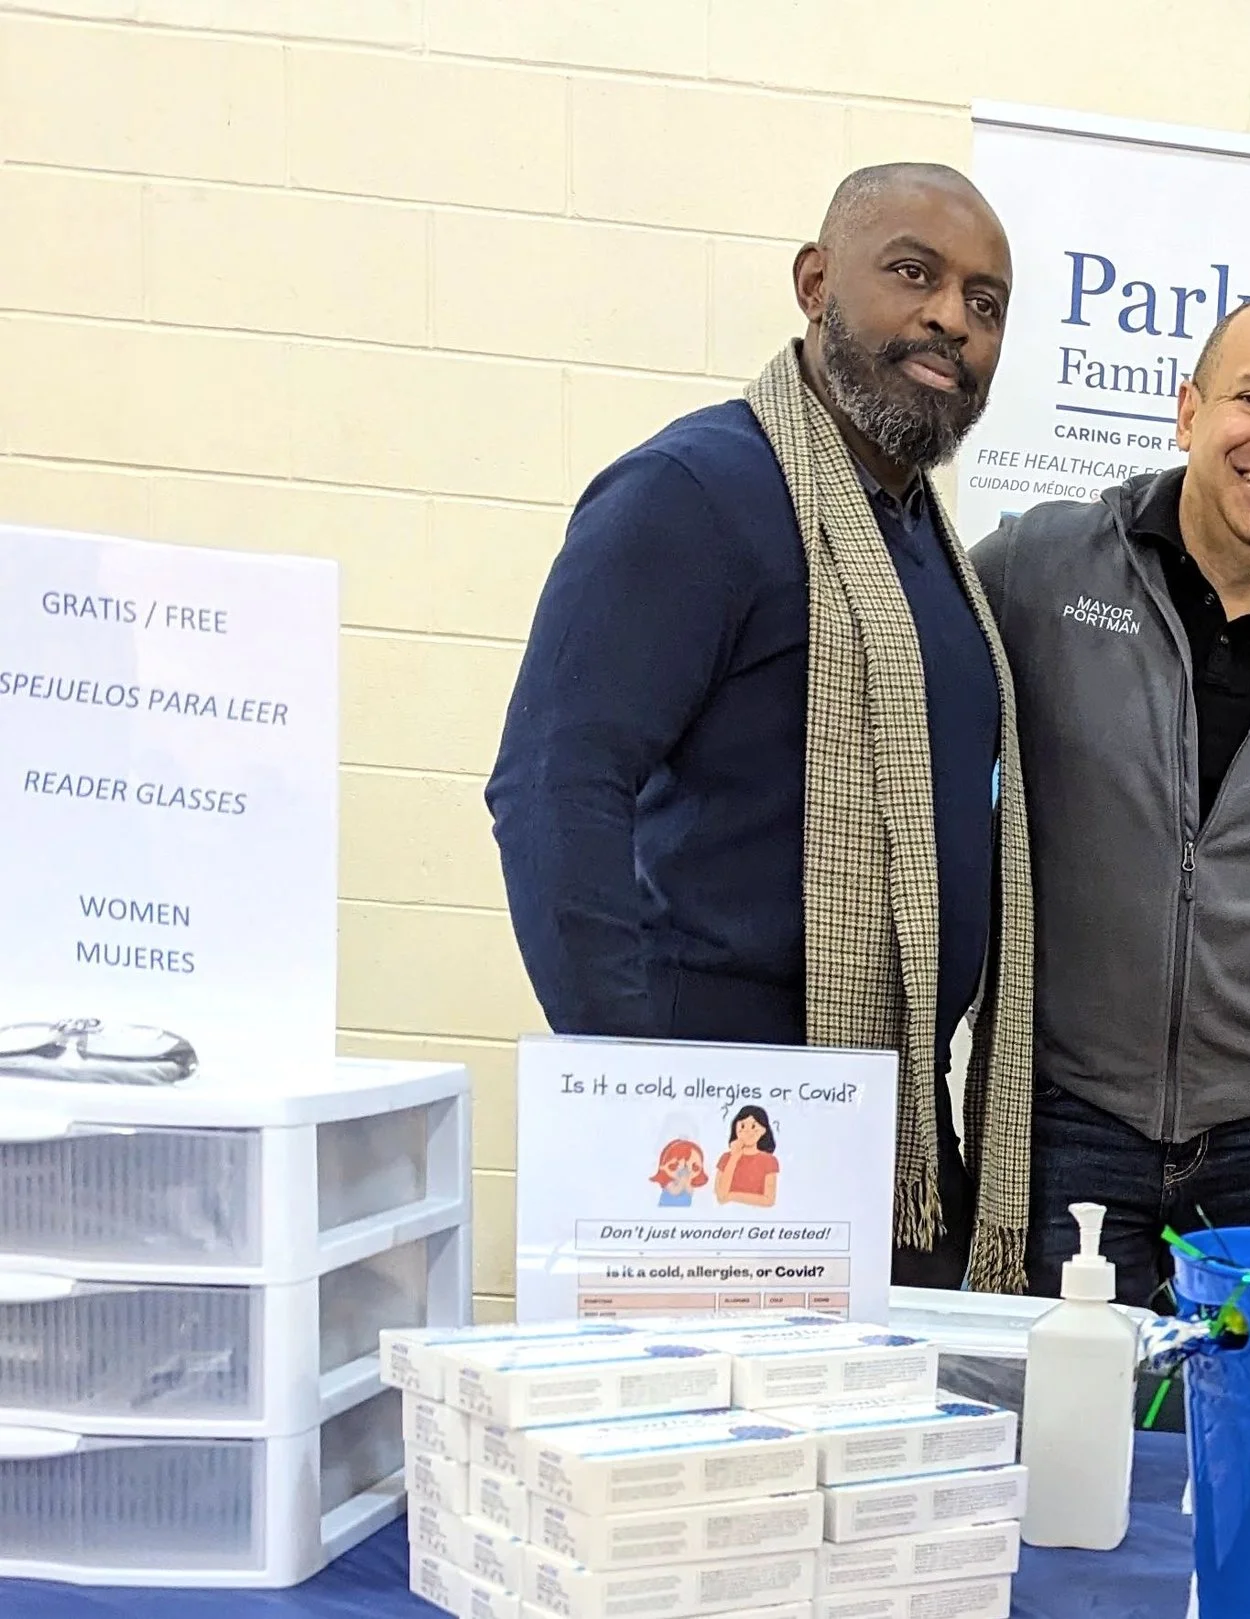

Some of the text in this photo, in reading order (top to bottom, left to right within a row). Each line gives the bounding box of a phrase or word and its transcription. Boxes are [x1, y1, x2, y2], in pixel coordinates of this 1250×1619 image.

[1054, 425, 1121, 445] CARING
[1127, 434, 1161, 450] FOR
[977, 449, 1020, 467] FREE
[1024, 453, 1139, 479] HEALTHCARE
[970, 476, 1029, 492] CUIDADO
[1033, 480, 1086, 498] MÉDICO
[42, 591, 228, 634] GRATIS / FREE
[1063, 605, 1141, 635] PORTMAN
[1077, 595, 1133, 621] MAYOR
[0, 671, 288, 726] SPEJUELOS PARA LEER
[23, 770, 247, 816] READER GLASSES
[79, 895, 191, 927] WOMEN
[76, 941, 195, 973] MUJERES
[561, 1073, 857, 1106] Is it a cold, allergies or Covid?
[600, 1224, 831, 1242] Don't just wonder! Get tested!
[622, 1265, 635, 1278] it
[637, 1268, 646, 1278] a
[649, 1265, 683, 1279] cold,
[686, 1265, 753, 1281] allergies,
[756, 1267, 772, 1278] or
[775, 1265, 825, 1278] Covid?
